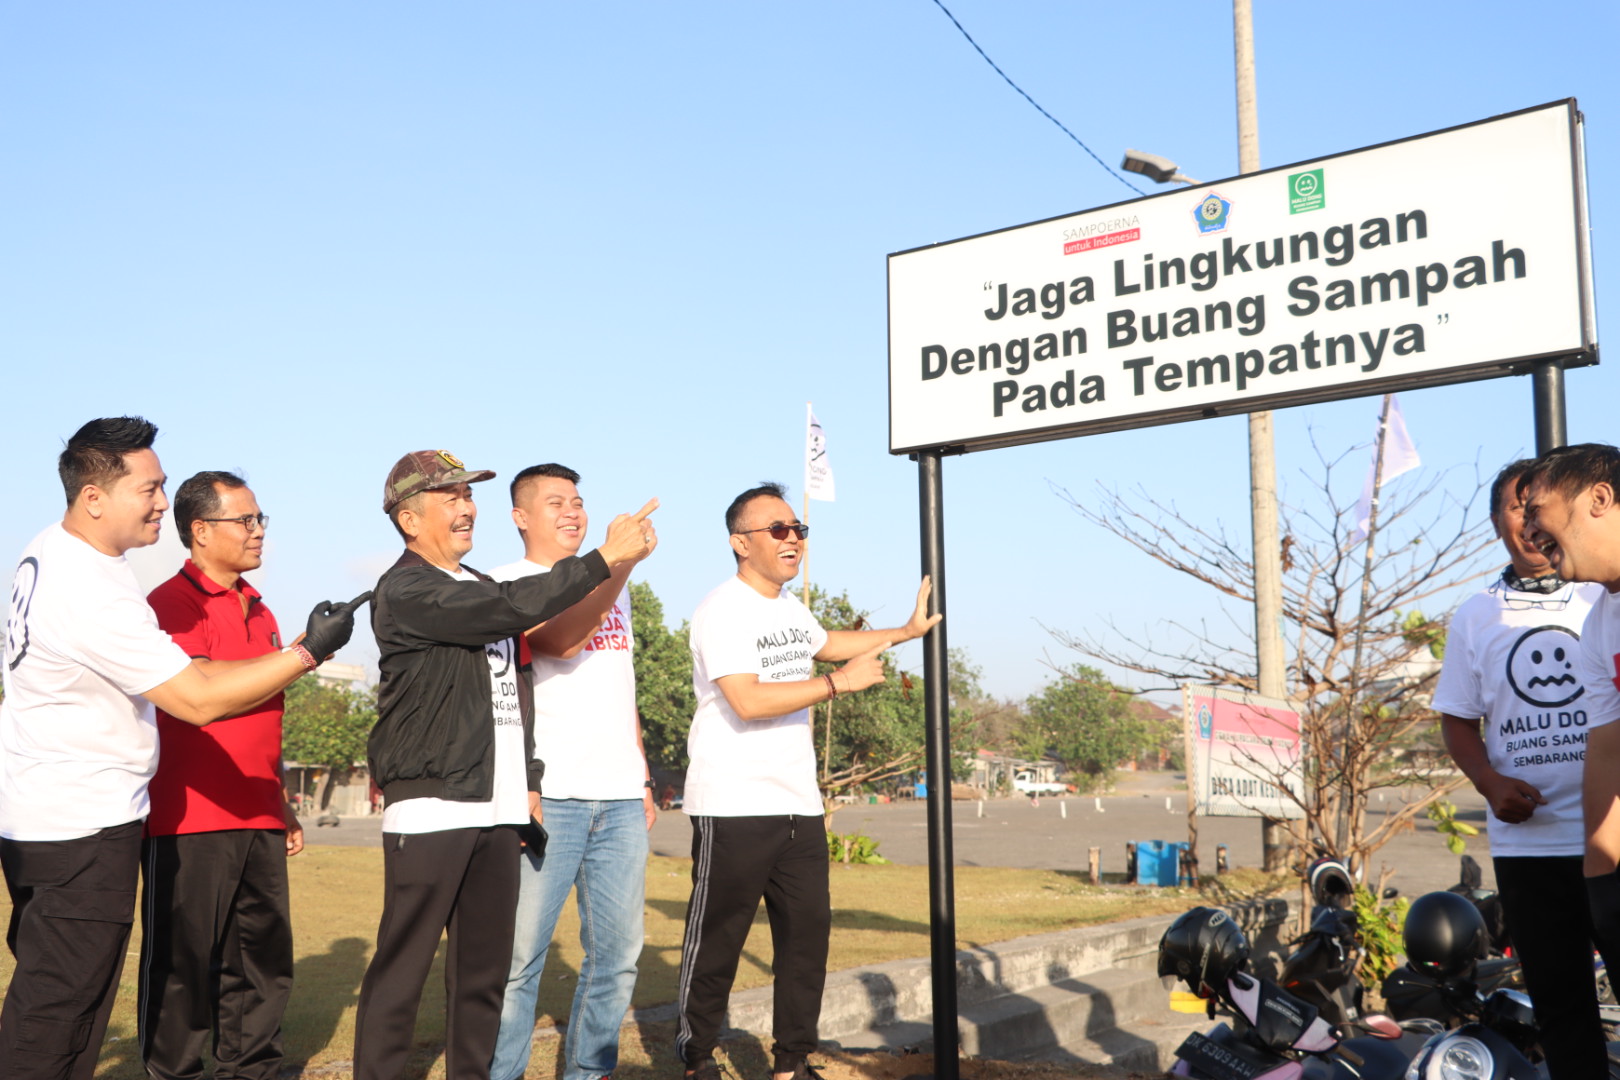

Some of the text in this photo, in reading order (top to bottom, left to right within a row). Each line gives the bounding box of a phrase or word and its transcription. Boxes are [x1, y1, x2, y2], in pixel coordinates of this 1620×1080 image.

[1063, 215, 1140, 241] SAMPOERNA
[1065, 230, 1139, 253] untuk Indonesia
[1114, 209, 1428, 297] Lingkungan
[921, 239, 1527, 381] Dengan Buang Sampah
[993, 369, 1106, 418] Pada
[585, 634, 629, 652] BISA
[1500, 712, 1551, 737] MALU
[1505, 735, 1548, 752] BUANG
